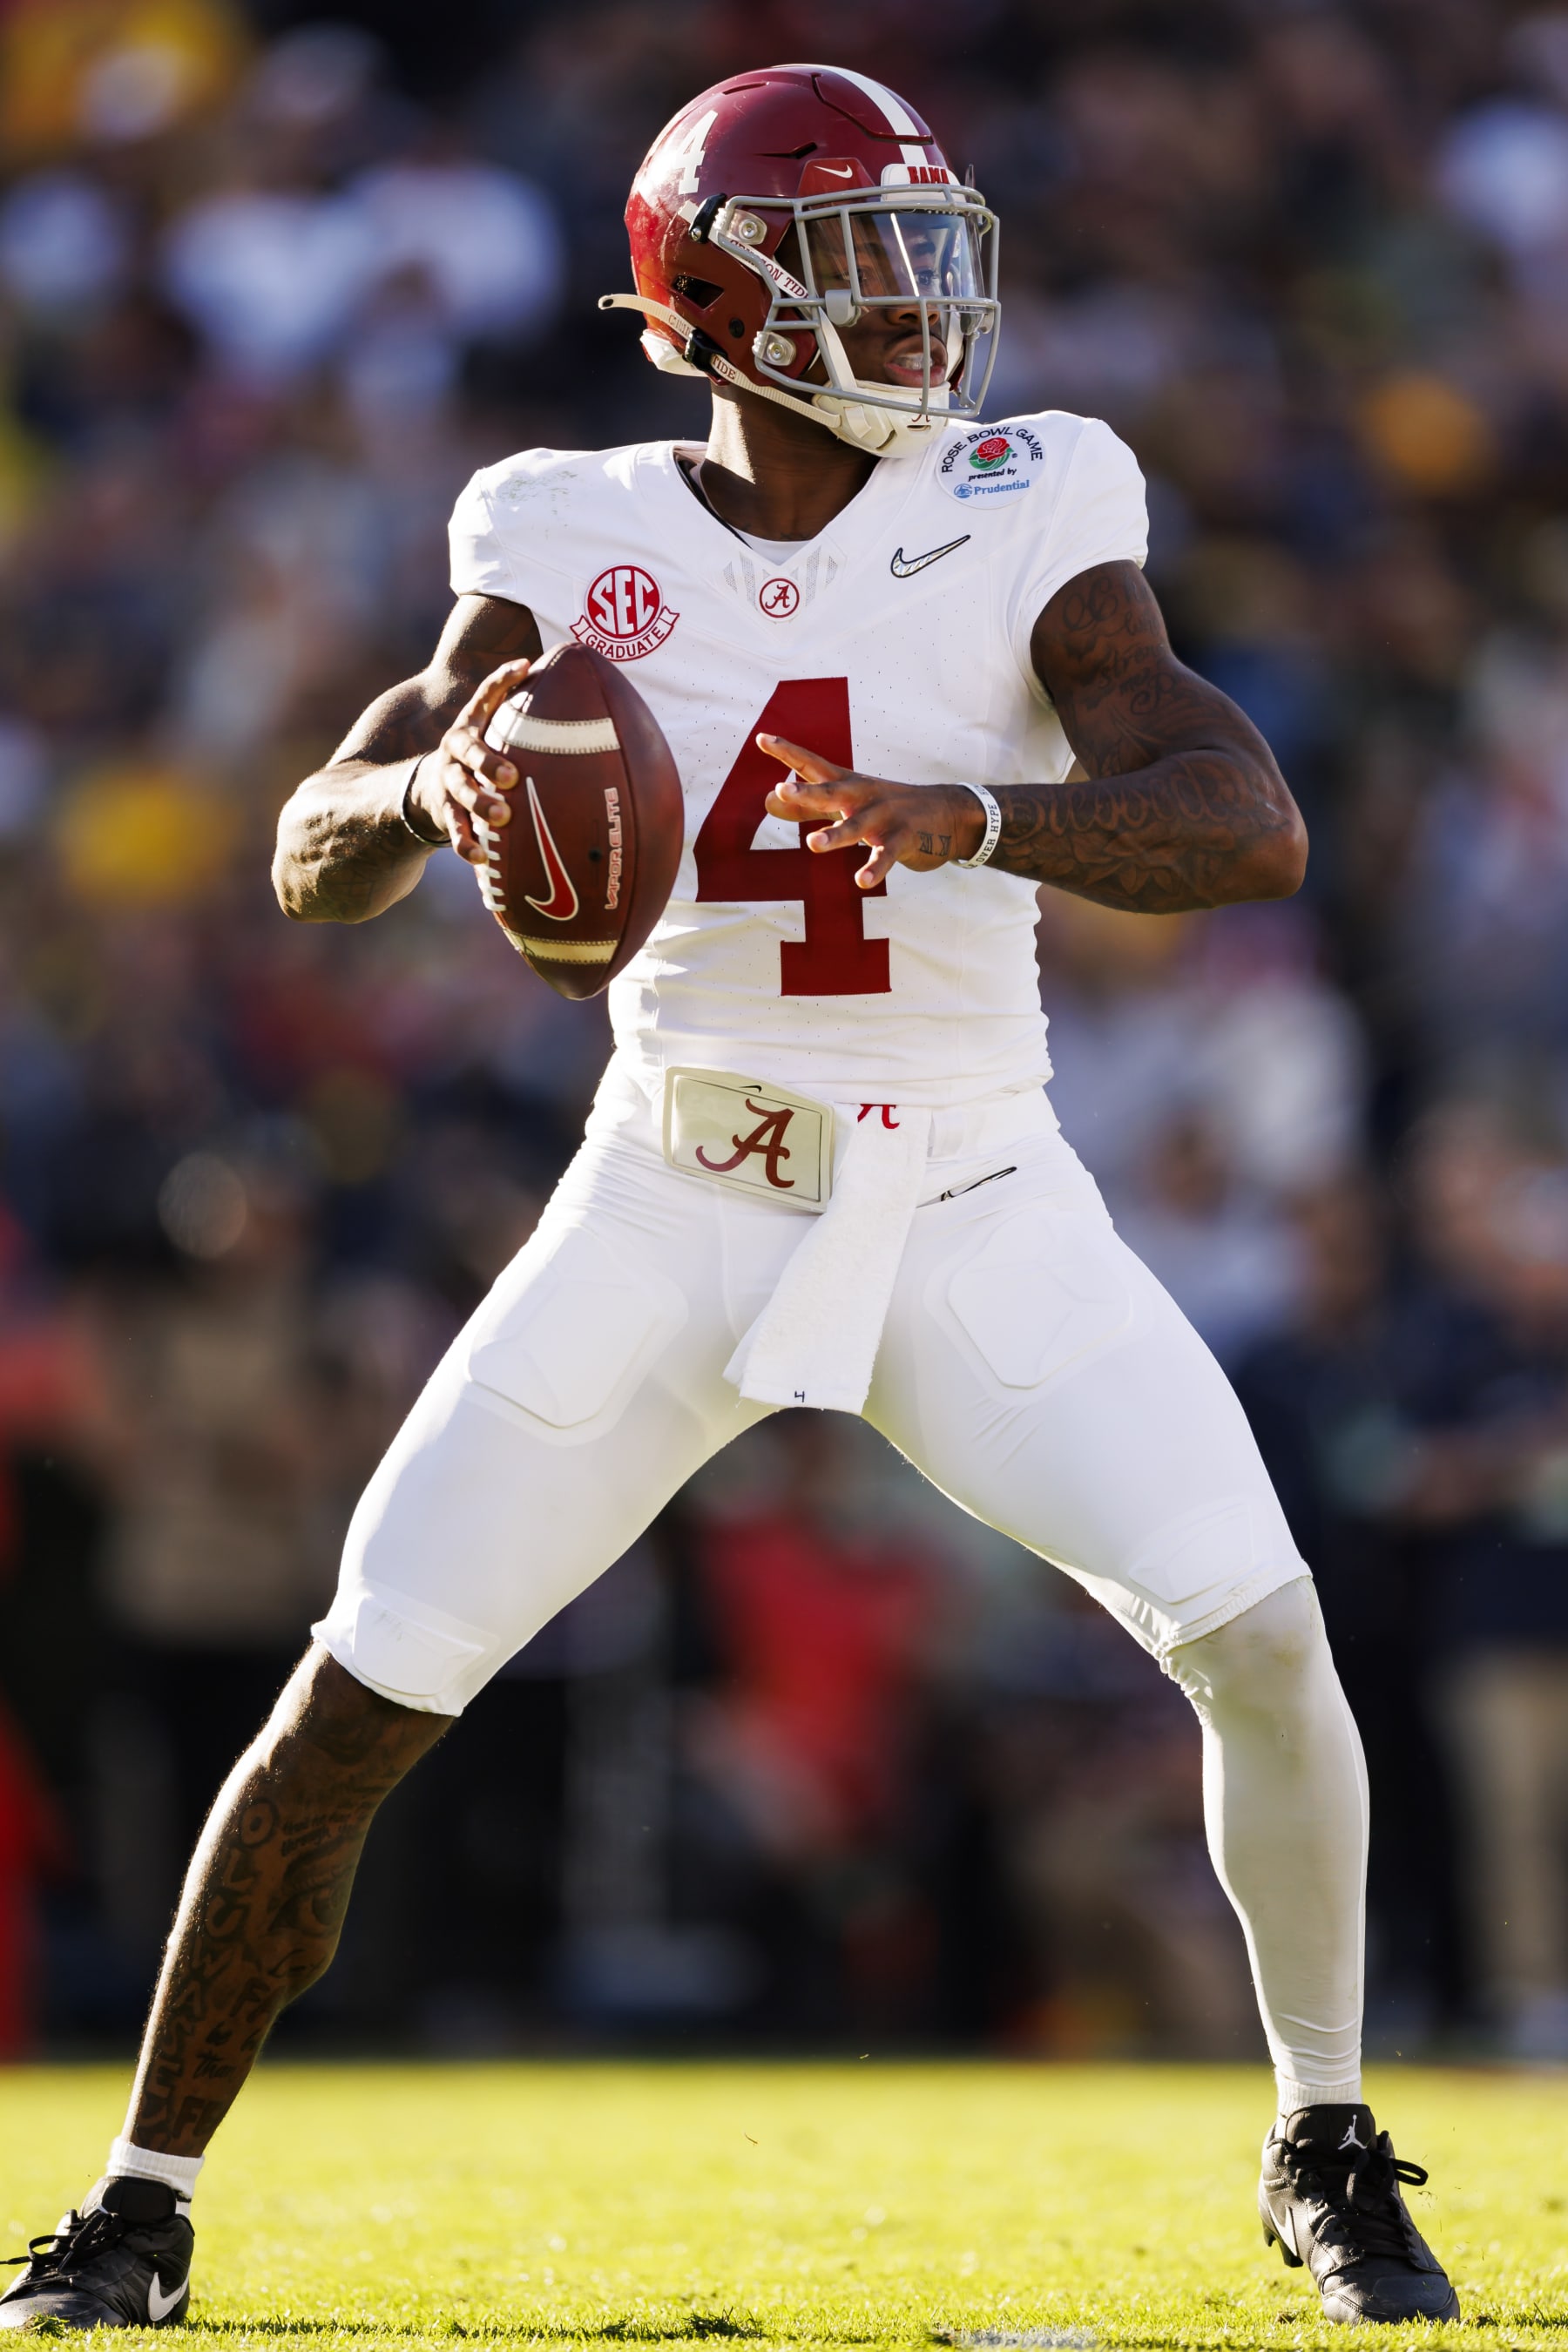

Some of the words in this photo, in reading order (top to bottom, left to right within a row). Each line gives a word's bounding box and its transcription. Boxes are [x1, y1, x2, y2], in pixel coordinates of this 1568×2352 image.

[671, 110, 718, 195] 4
[907, 166, 950, 185] BAMA
[783, 276, 808, 299] TID
[713, 355, 736, 380] TIDE
[941, 442, 967, 473] ROSE
[967, 426, 1013, 443] BOWL
[1016, 429, 1043, 461] GAME
[968, 469, 1004, 482] presented
[974, 479, 1030, 495] Prudential
[591, 569, 655, 635] SEC
[765, 585, 790, 609] A
[585, 626, 665, 659] GRADUATE
[604, 787, 622, 848] ELITE
[693, 677, 891, 996] 4
[976, 839, 996, 862] OVER
[988, 804, 999, 833] HYPE
[604, 847, 622, 909] VAPOR
[696, 1098, 794, 1188] A
[794, 1390, 805, 1402] 4
